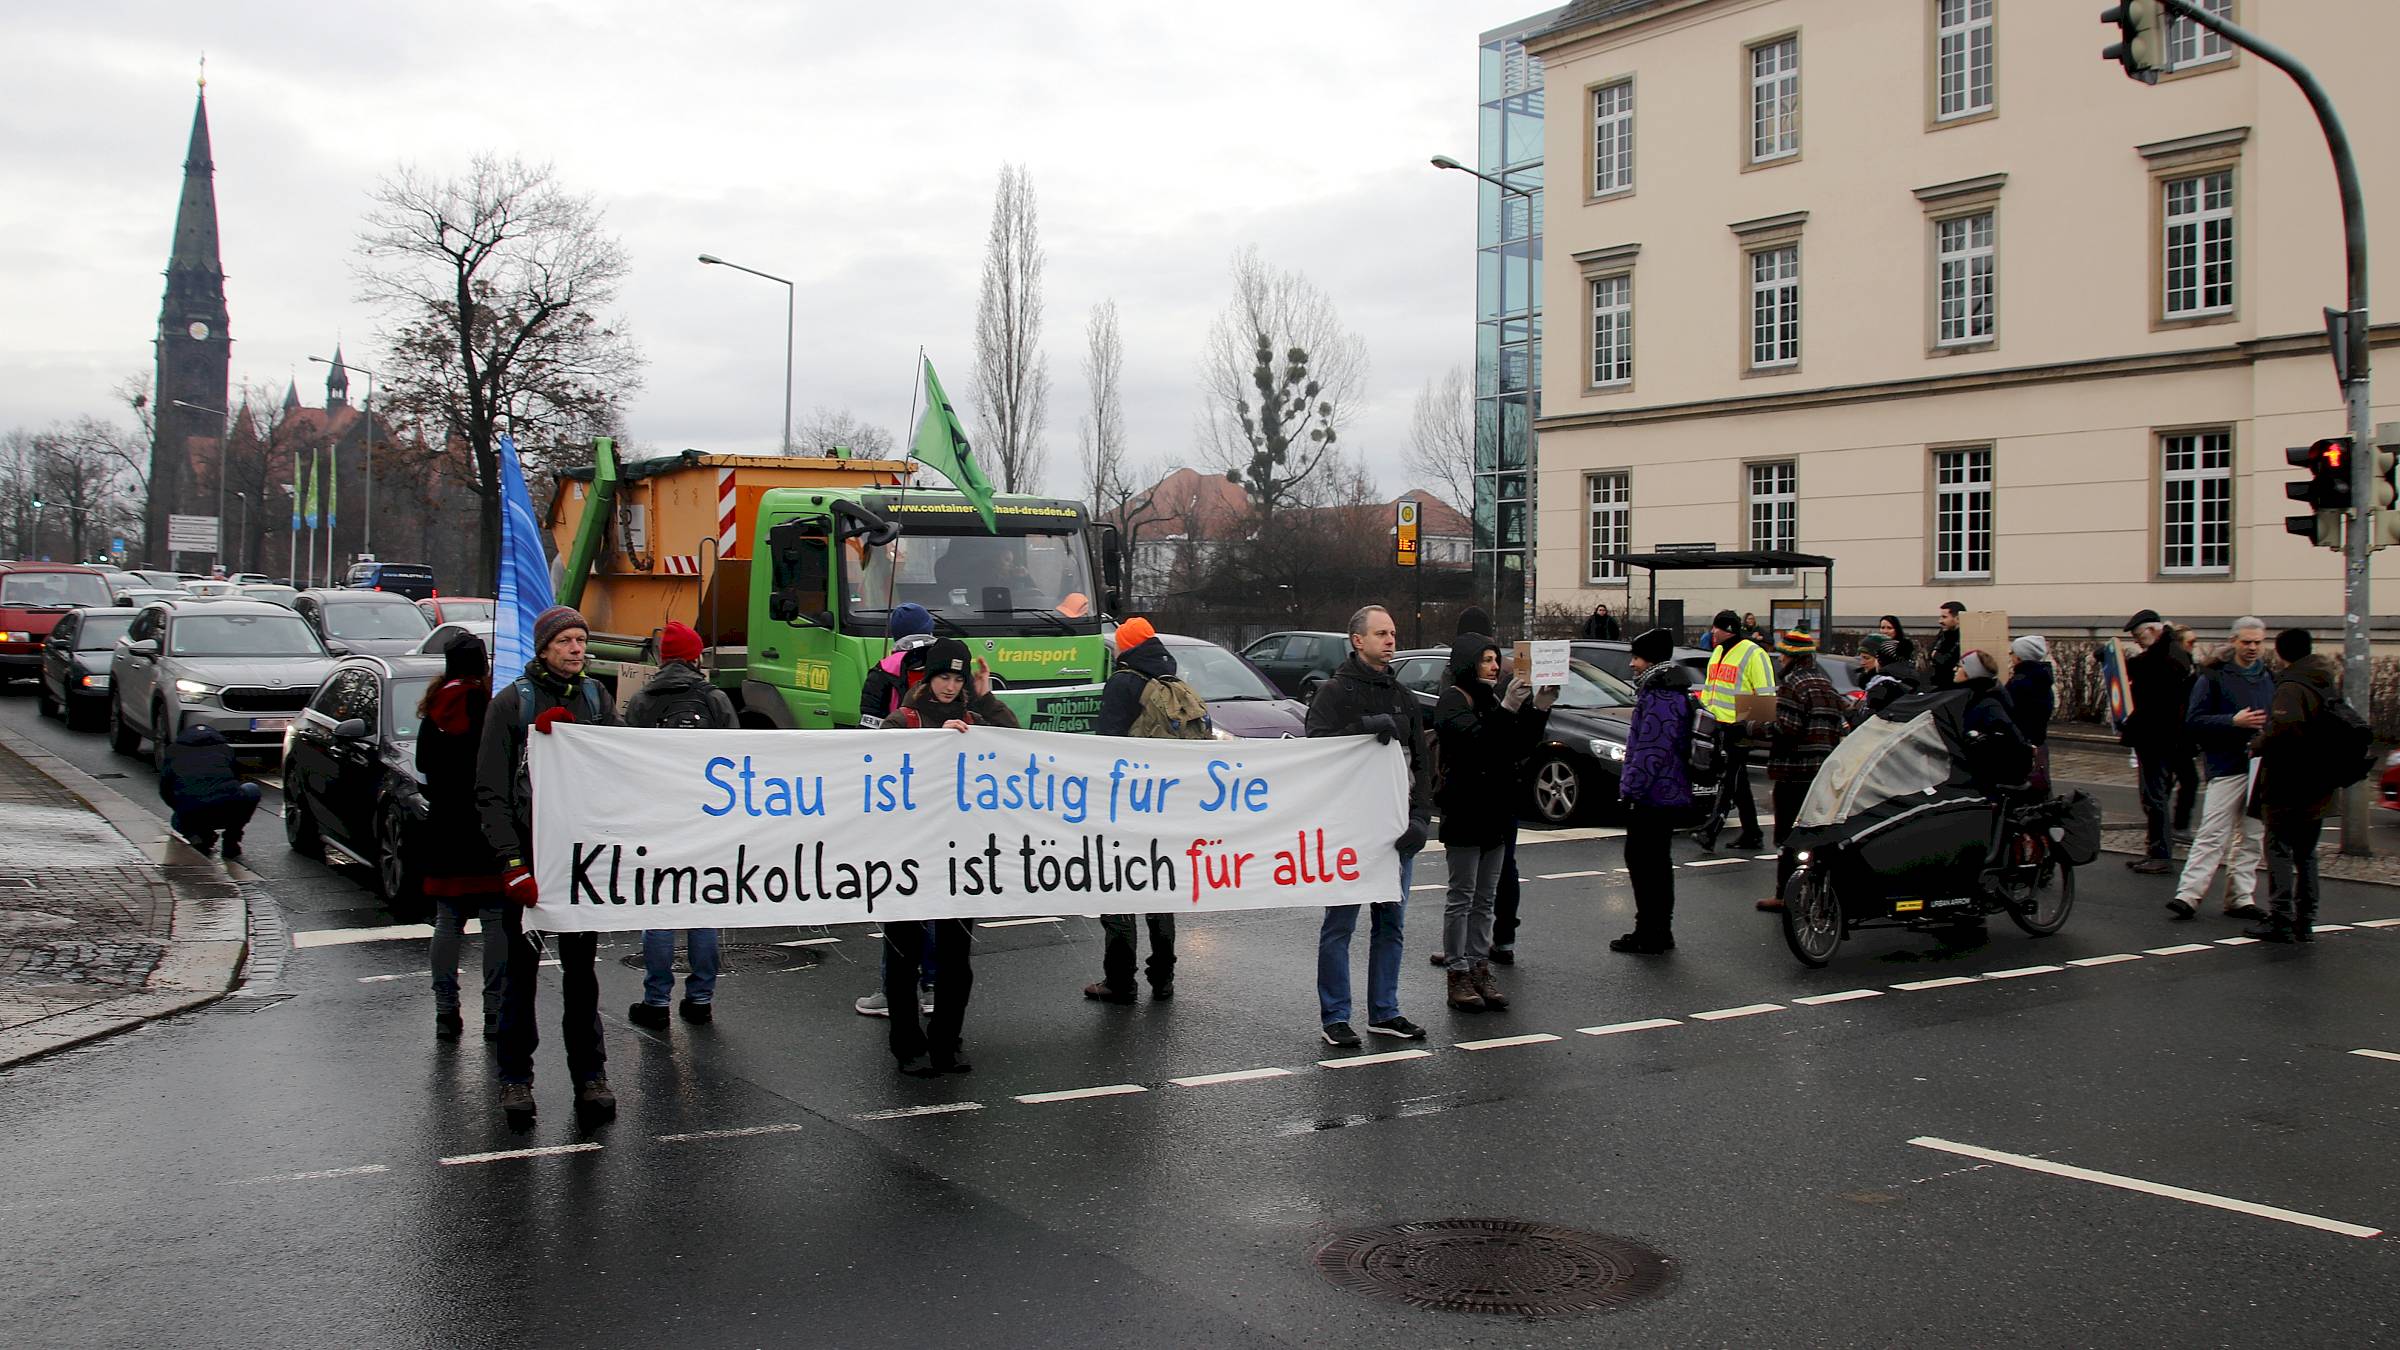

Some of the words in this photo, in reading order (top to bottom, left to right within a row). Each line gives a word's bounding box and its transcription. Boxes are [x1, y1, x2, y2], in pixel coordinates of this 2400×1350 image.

[888, 503, 1077, 518] www.container-hael-dresden.de
[998, 648, 1077, 665] transport
[621, 663, 639, 678] Wir
[702, 755, 825, 816] Stau
[863, 753, 916, 813] ist
[957, 752, 1088, 823] lästig
[1110, 758, 1180, 823] für
[1200, 760, 1269, 811] Sie
[570, 841, 919, 913] Klimakollaps
[949, 833, 1003, 896] ist
[1020, 834, 1176, 894] tödlich
[1186, 838, 1255, 903] für
[1273, 828, 1360, 887] alle
